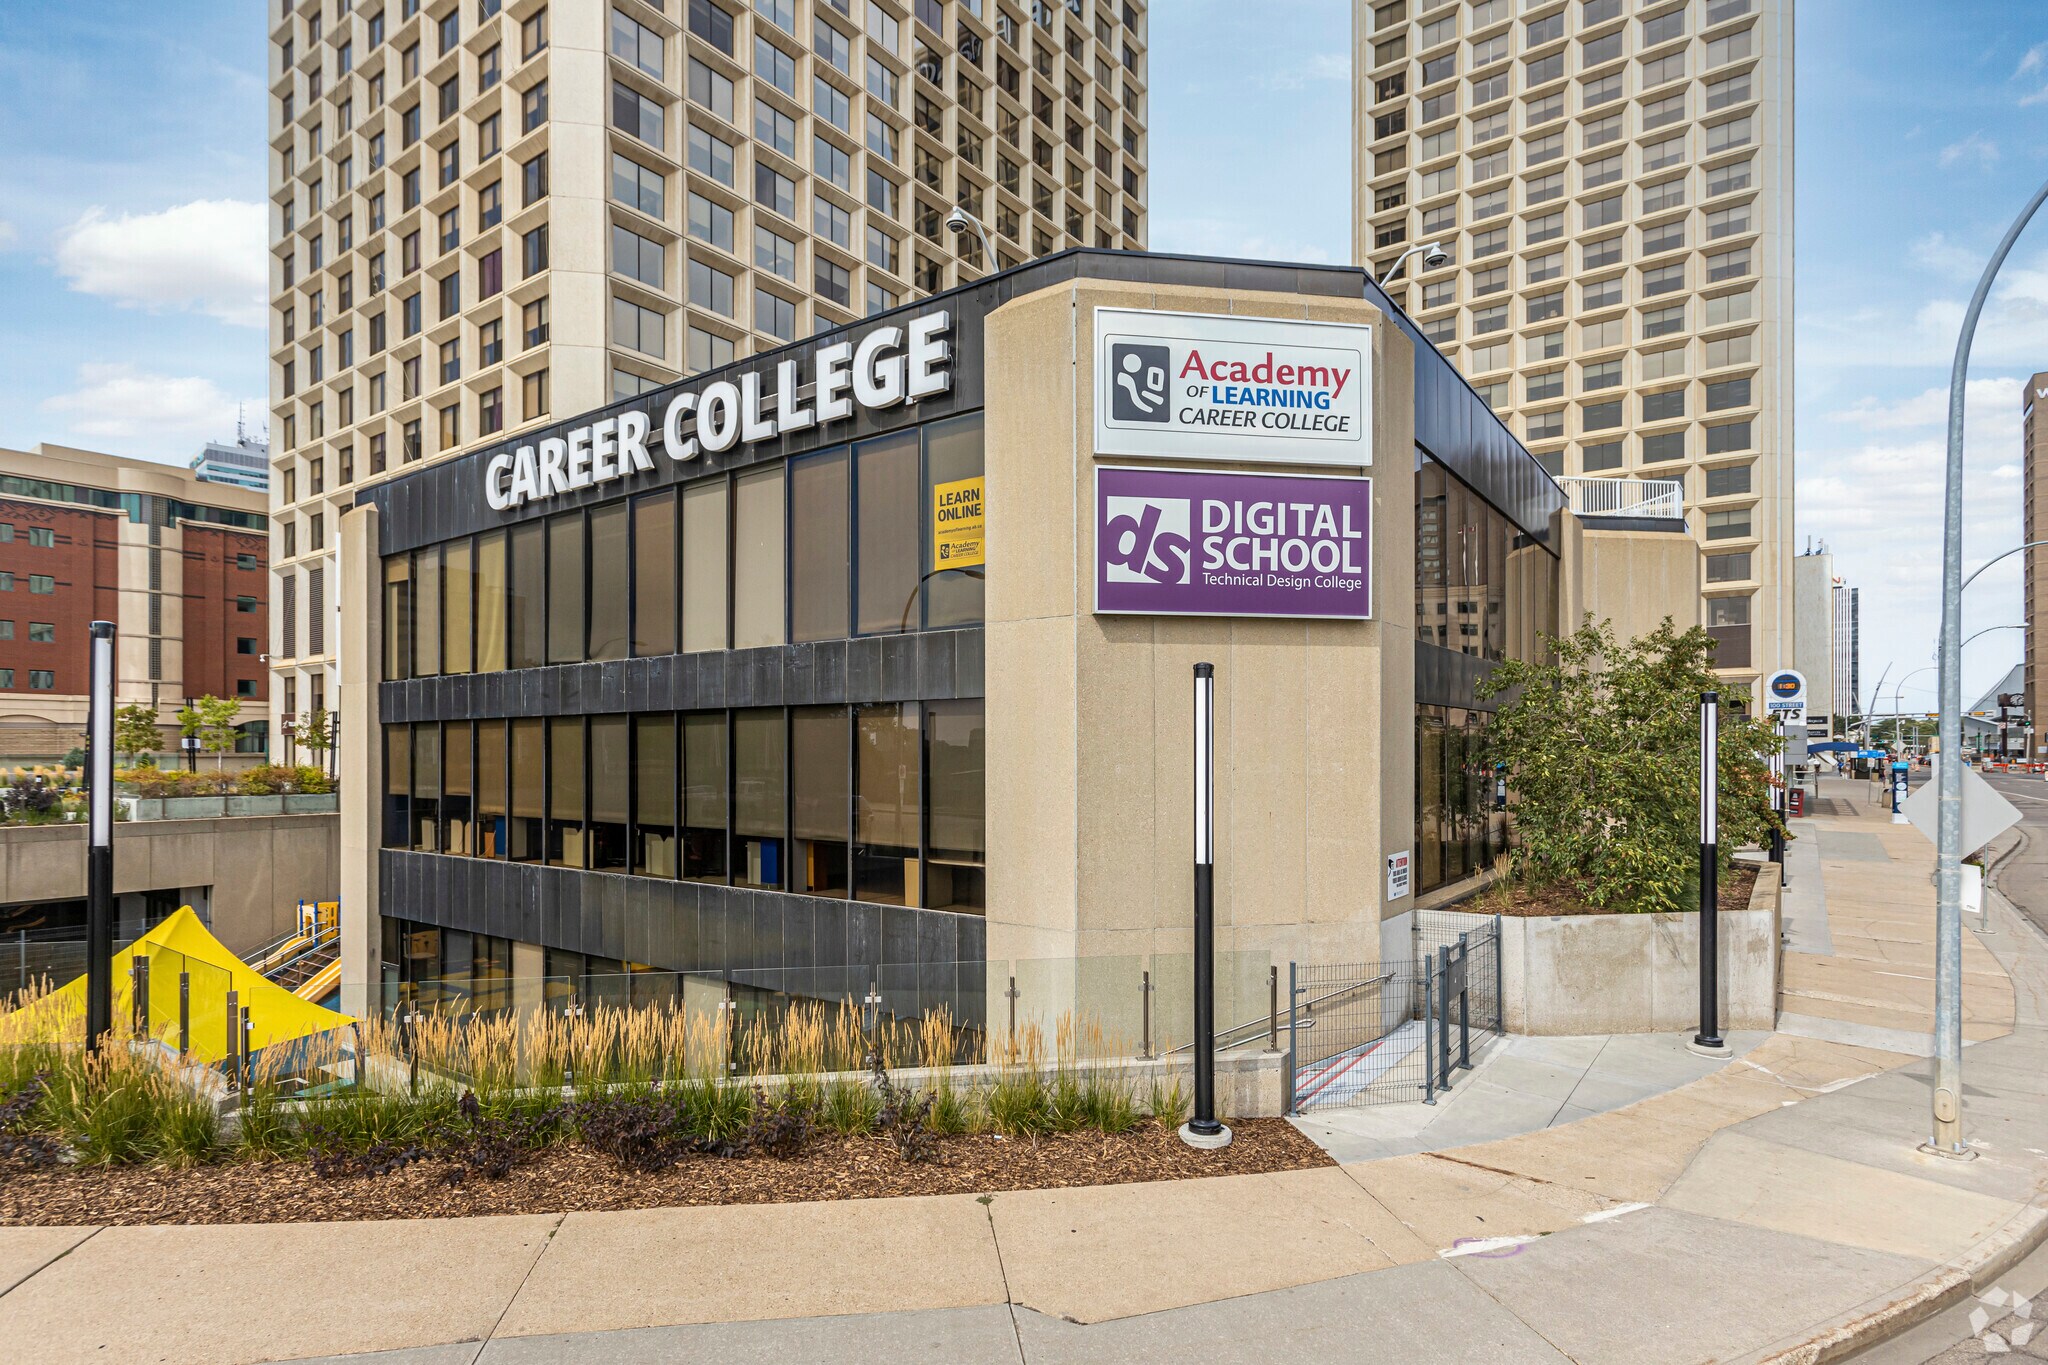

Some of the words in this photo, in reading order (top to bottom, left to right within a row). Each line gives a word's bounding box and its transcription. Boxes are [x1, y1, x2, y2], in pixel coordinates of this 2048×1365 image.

[1179, 350, 1351, 399] Academy
[1186, 385, 1209, 398] OF
[1212, 386, 1330, 410] LEARNING
[485, 410, 655, 510] CAREER
[663, 310, 950, 461] COLLEGE
[1179, 408, 1256, 428] CAREER
[1262, 412, 1350, 432] COLLEGE
[940, 488, 979, 506] LEARN
[938, 503, 981, 521] ONLINE
[1202, 500, 1362, 539] DIGITAL
[951, 541, 979, 549] Academy
[1202, 536, 1362, 574] SCHOOL
[1202, 572, 1263, 587] Technical
[1266, 573, 1311, 590] Design
[1314, 575, 1362, 592] College
